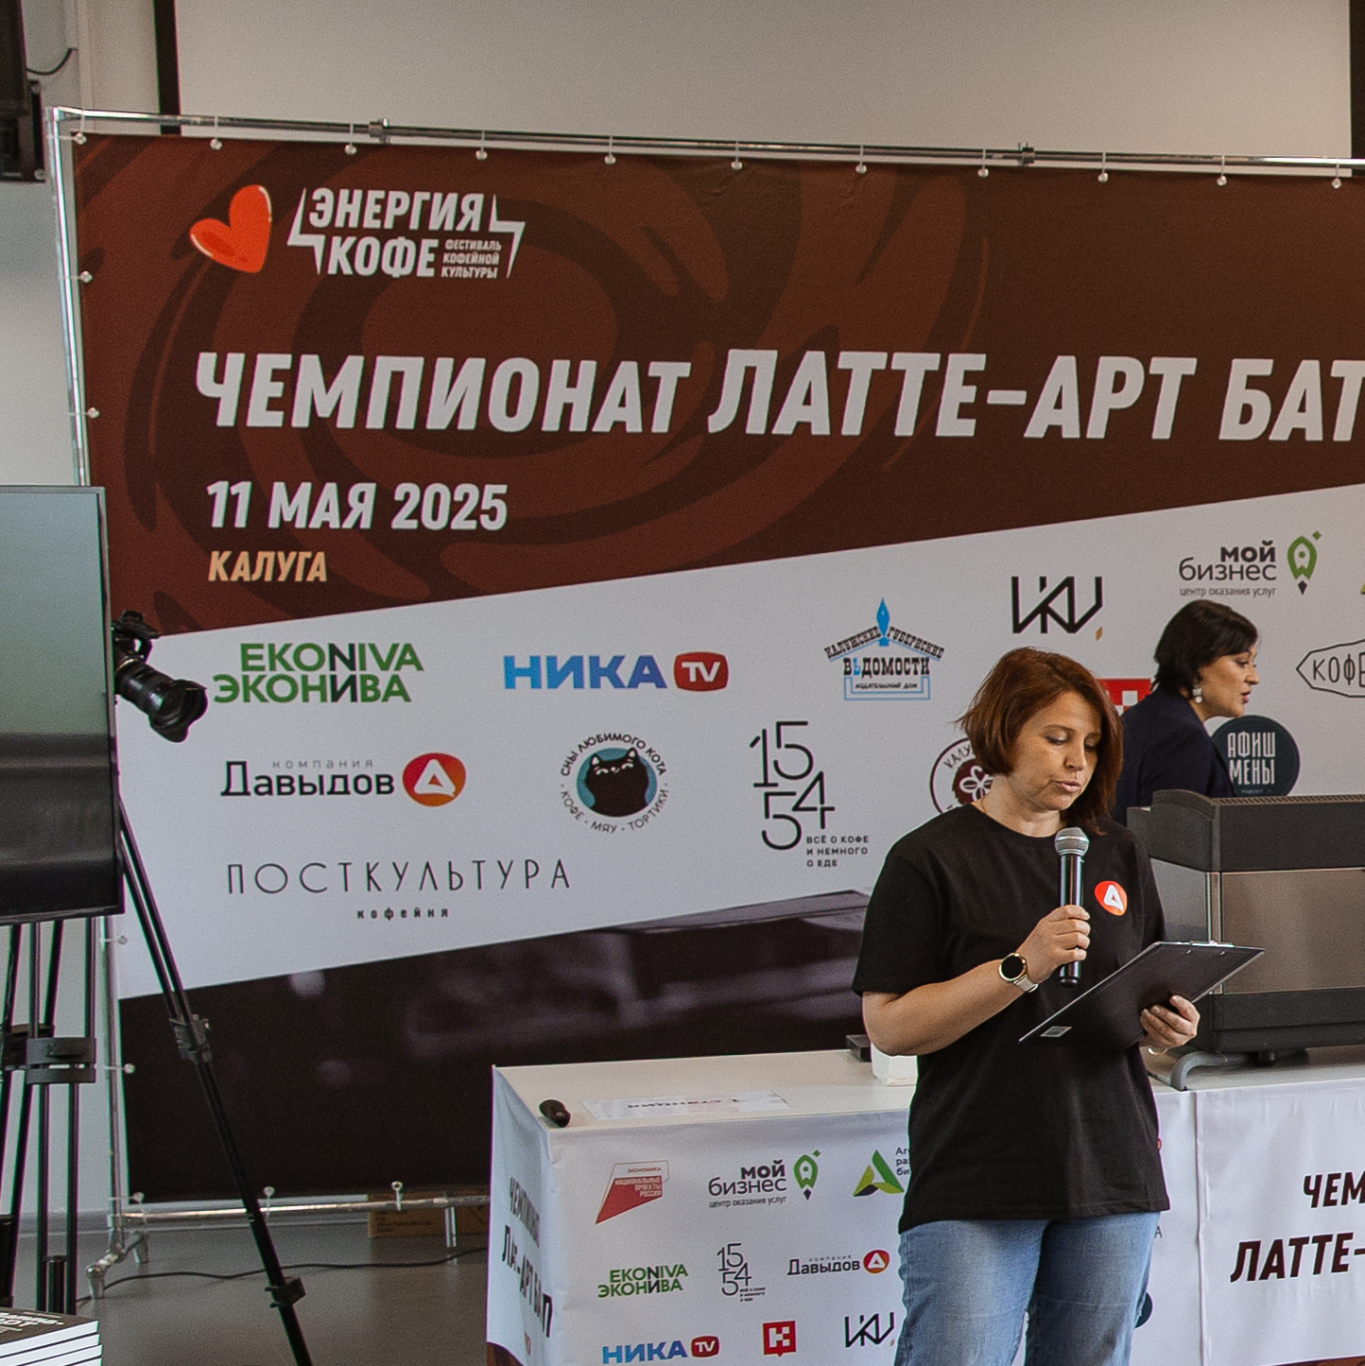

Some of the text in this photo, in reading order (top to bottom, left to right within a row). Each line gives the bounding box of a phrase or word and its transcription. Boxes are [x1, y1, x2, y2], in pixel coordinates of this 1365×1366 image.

[309, 187, 484, 232] ЭНЕРГИЯ
[327, 235, 439, 278] КОФЕ
[444, 239, 502, 251] ФЕСТИВАЛЬ
[443, 252, 500, 265] КОФЕЙНОЙ
[441, 266, 498, 279] КУЛЬТУРЫ
[196, 352, 692, 433] ЧЕМПИОНАТ
[708, 349, 1198, 440] ЛАТТЕ-АРТ
[207, 481, 508, 531] 11 МАЯ 2025
[1220, 540, 1276, 563] мой
[208, 551, 328, 582] КАЛУГА
[1179, 556, 1277, 581] бизнес
[1180, 588, 1277, 599] центр оказания услуг
[240, 642, 424, 672] EKONIVA
[503, 655, 668, 689] НИКА
[681, 661, 721, 683] TV
[212, 674, 412, 703] ЭКОНИВА
[561, 732, 667, 777] СНЫ ЛЮБИМОГО КОТА
[1227, 731, 1275, 758] АФИШ
[272, 759, 373, 769] компания
[1229, 759, 1275, 785] МЕНЫ
[221, 761, 395, 797] Давыдов
[561, 788, 669, 834] КОФЕ МЯУ ТОРТИКИ
[806, 834, 869, 844] ВСЁ О КОФЕ
[806, 846, 868, 856] И НЕМНОГО
[806, 858, 838, 868] О ЕДЕ
[227, 858, 570, 894] ПОСТКУЛЬТУРА
[357, 907, 449, 921] кофейня
[741, 1160, 785, 1180] мой
[708, 1177, 787, 1197] бизнес
[610, 1263, 689, 1284] EKONIVA
[787, 1259, 861, 1276] Давыдов
[598, 1278, 683, 1298] ЭКОНИВА
[602, 1340, 688, 1364] НИКА
[694, 1341, 716, 1354] TV
